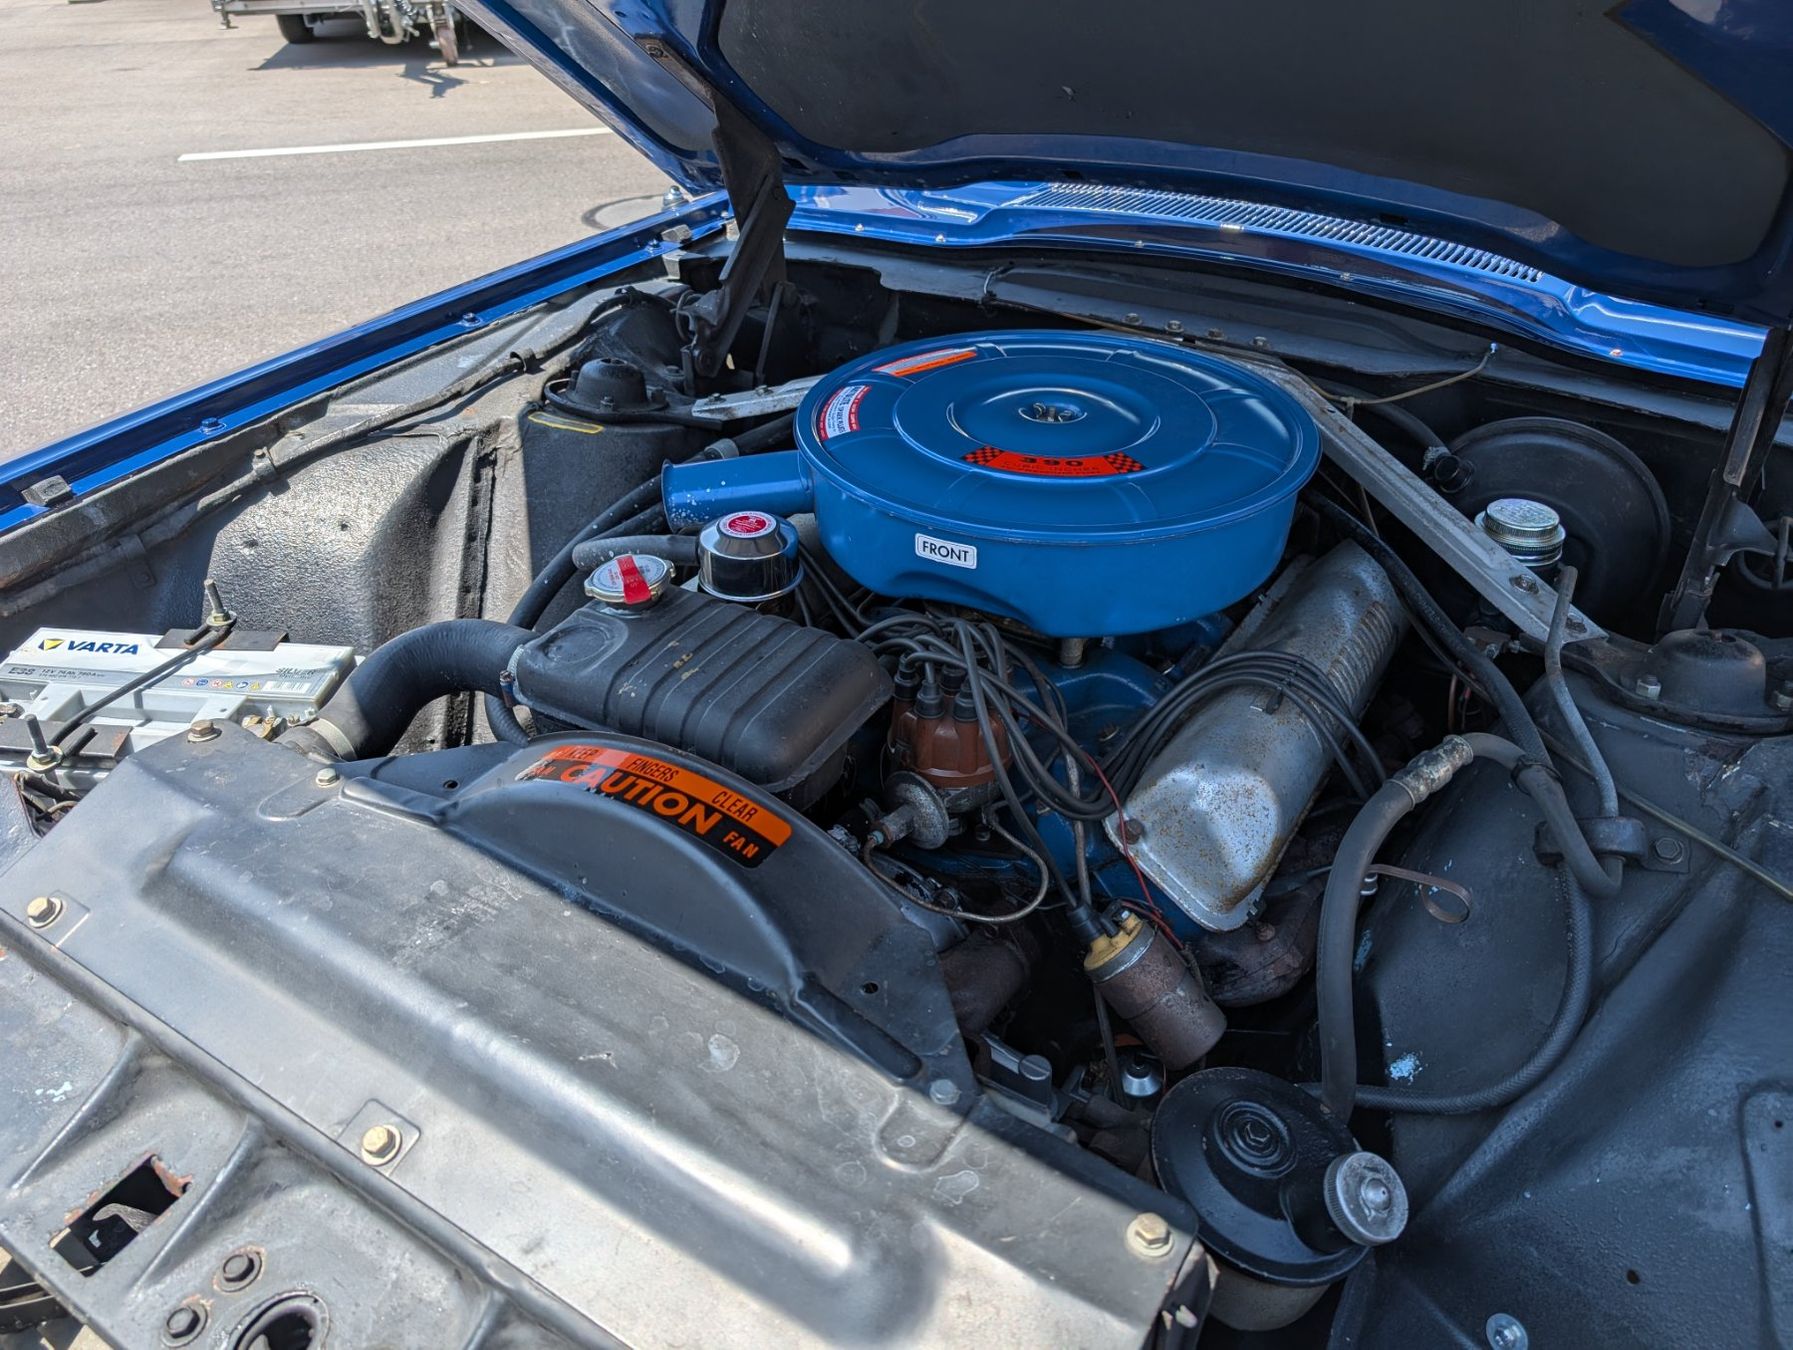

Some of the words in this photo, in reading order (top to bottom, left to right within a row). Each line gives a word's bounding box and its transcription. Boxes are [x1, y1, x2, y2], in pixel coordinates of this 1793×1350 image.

[1020, 456, 1083, 466] 390
[922, 540, 969, 562] FRONT
[67, 640, 140, 655] VARTA
[627, 758, 679, 782] FINGERS
[712, 790, 757, 822] CLEAR
[559, 763, 722, 835] CAUTION
[723, 830, 759, 858] FAN
